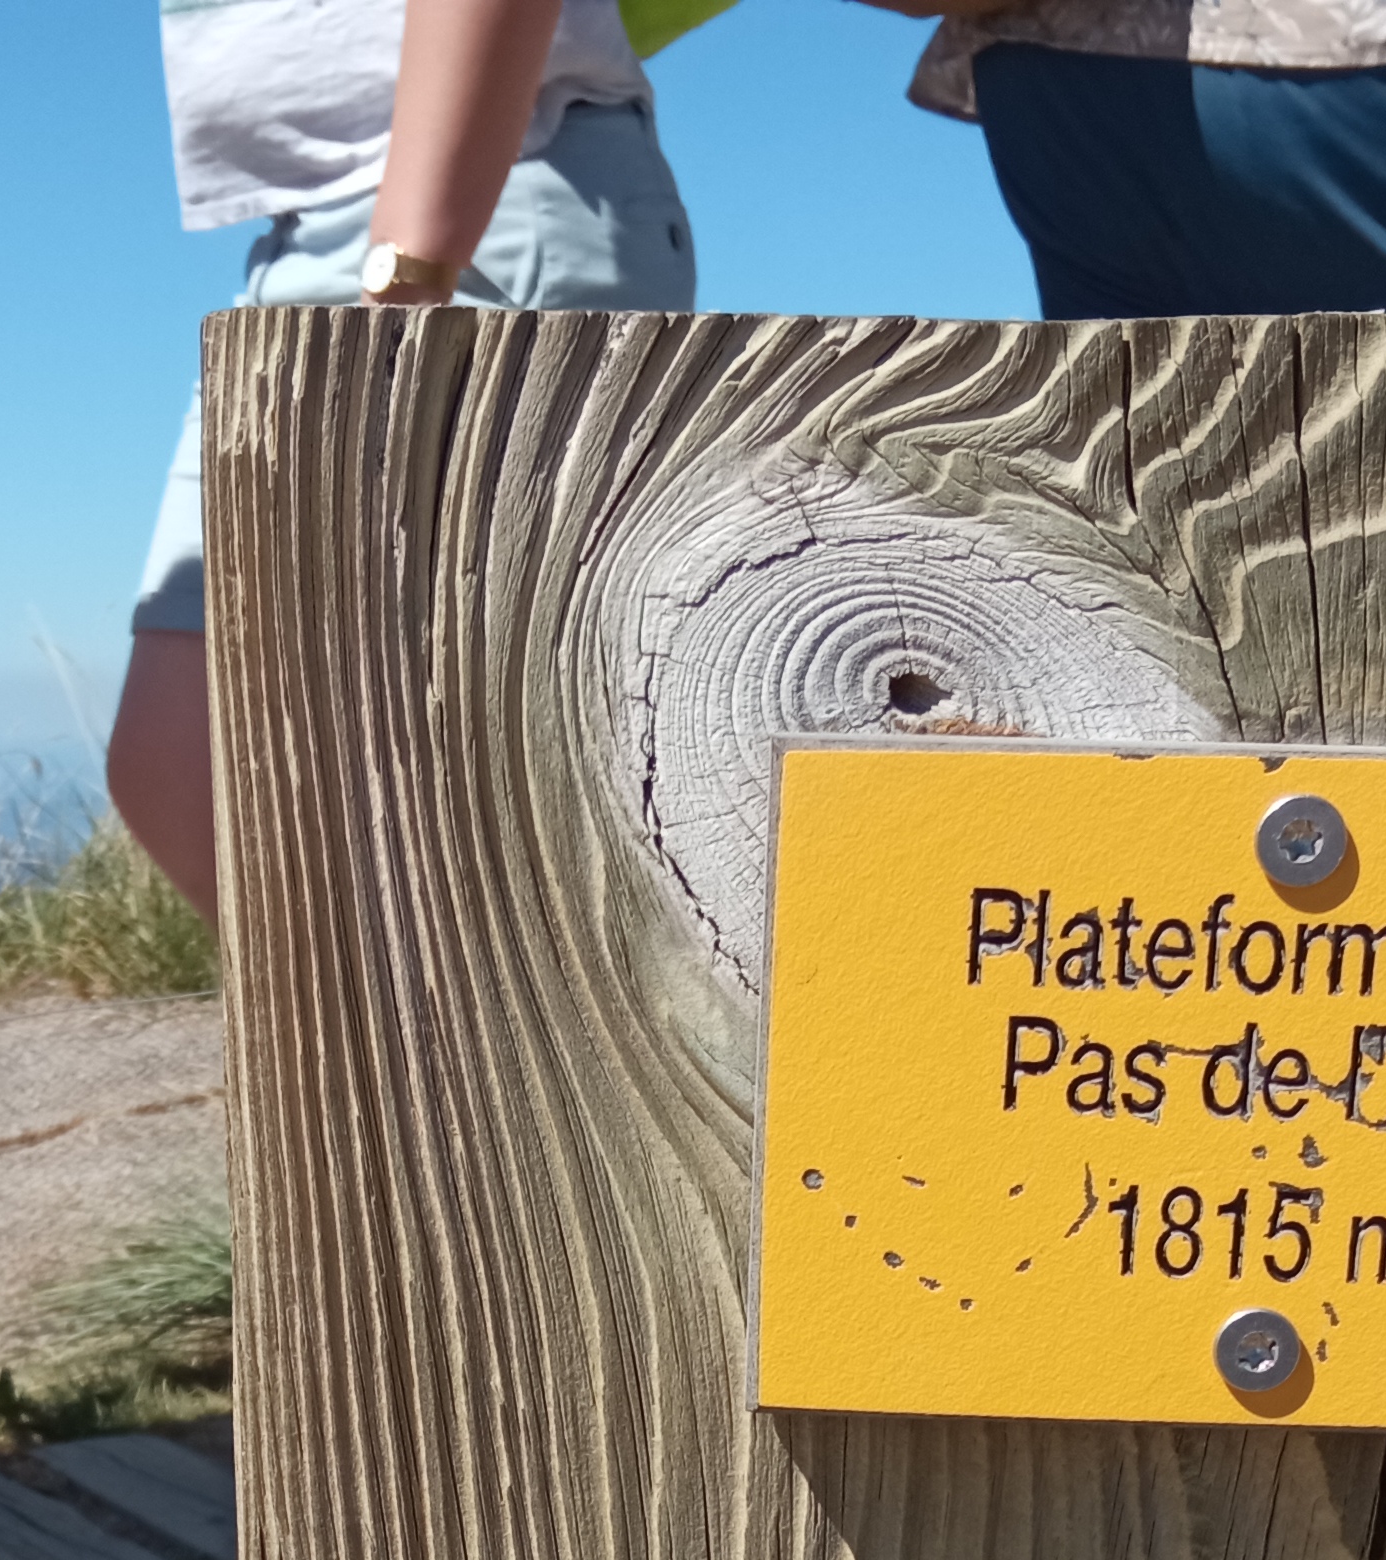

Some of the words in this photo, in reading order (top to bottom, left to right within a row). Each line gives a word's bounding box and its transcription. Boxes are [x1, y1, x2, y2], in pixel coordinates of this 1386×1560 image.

[1000, 1015, 1167, 1122] Pas
[1201, 1022, 1311, 1122] de
[1109, 1184, 1316, 1284] 1815
